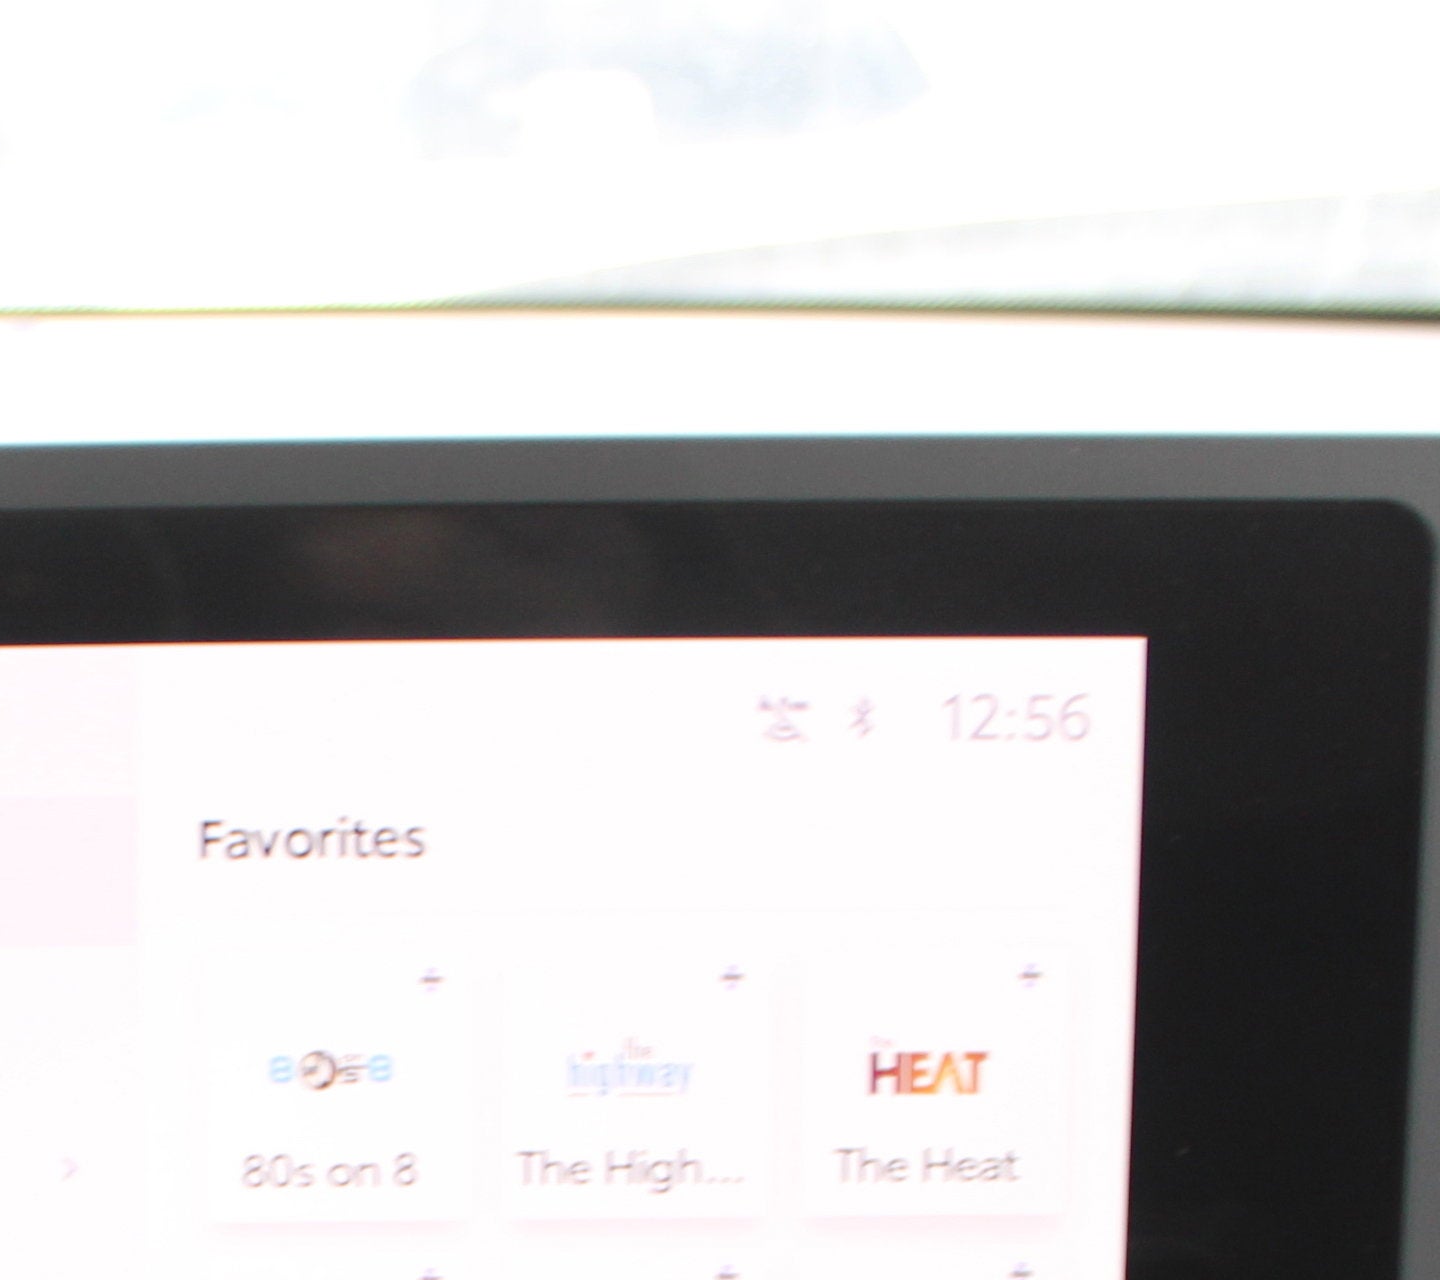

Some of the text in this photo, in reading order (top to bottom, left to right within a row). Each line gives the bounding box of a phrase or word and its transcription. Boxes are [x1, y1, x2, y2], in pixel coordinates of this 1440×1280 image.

[943, 693, 1091, 742] 12:56
[200, 817, 425, 860] Favorites
[869, 1052, 988, 1095] HEAT
[242, 1152, 417, 1189] 80s on 8
[516, 1150, 592, 1186] The
[833, 1147, 1019, 1183] The Heat
